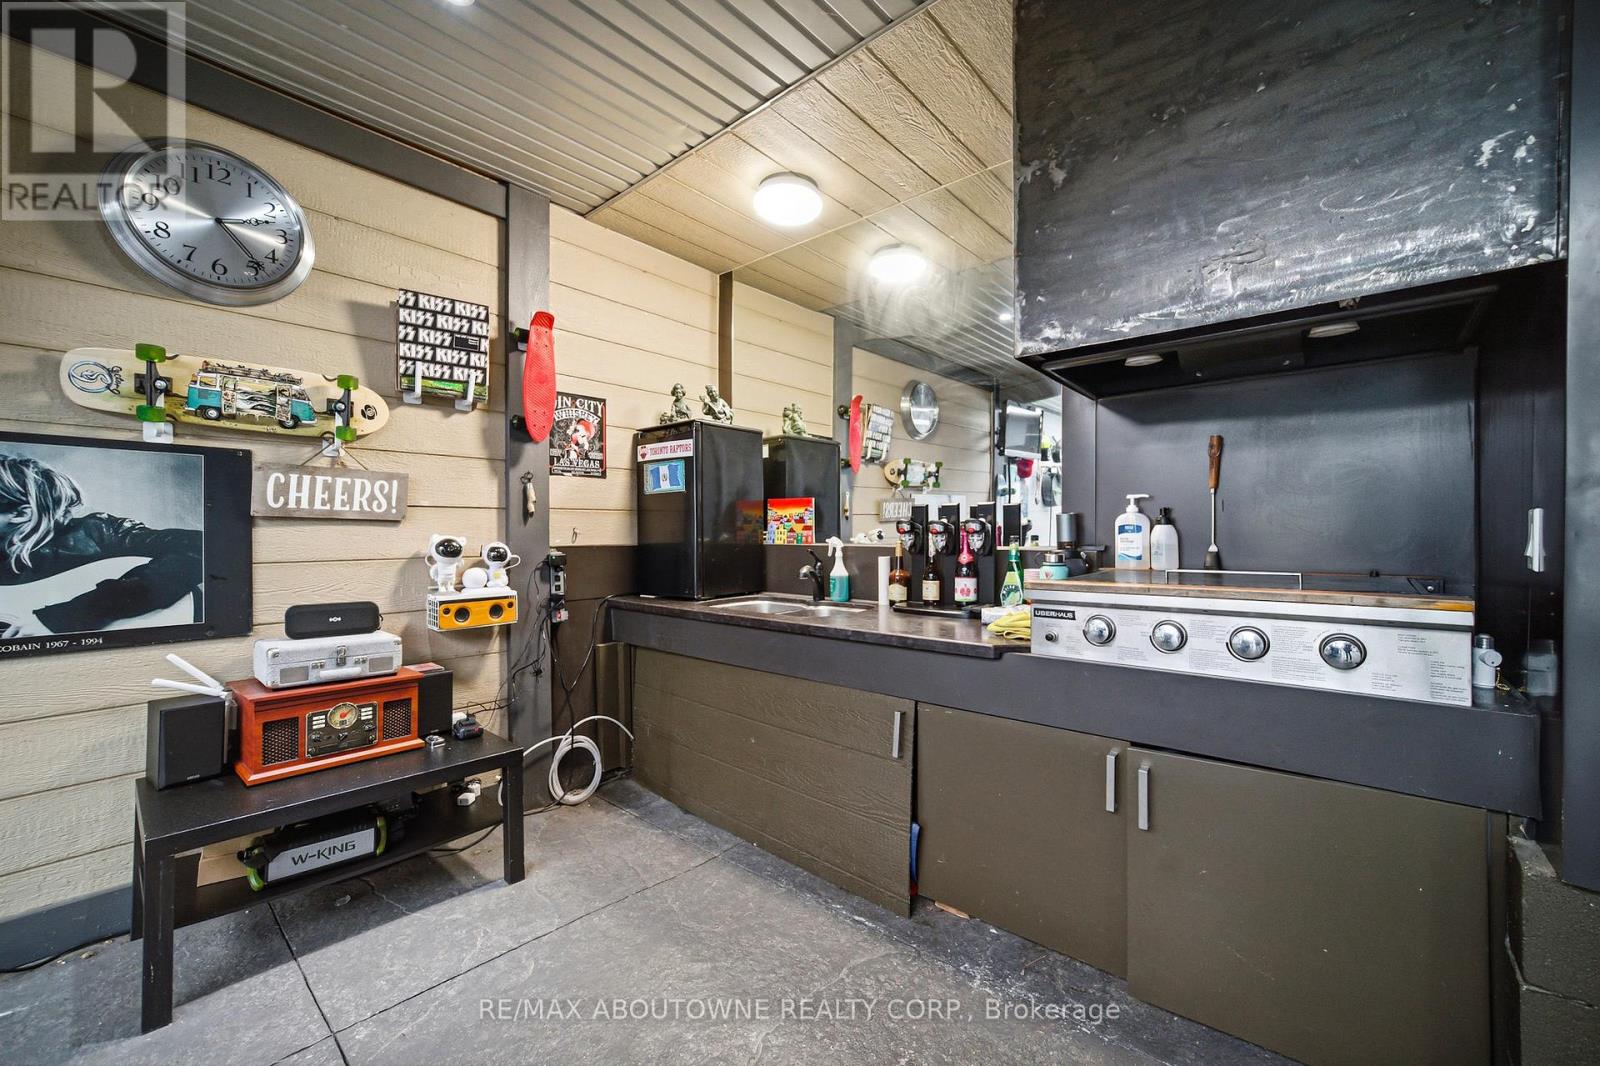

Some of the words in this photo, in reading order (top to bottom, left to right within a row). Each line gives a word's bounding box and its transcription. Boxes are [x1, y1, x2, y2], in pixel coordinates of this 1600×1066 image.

[180, 162, 200, 184] 11
[206, 163, 231, 186] 12
[154, 174, 181, 195] 10
[246, 182, 252, 198] 1
[141, 192, 160, 211] 9
[264, 202, 277, 219] 2
[153, 221, 171, 239] 8
[276, 229, 288, 245] 3
[183, 244, 198, 262] 7
[265, 248, 279, 264] 4
[211, 259, 228, 276] 6
[399, 290, 416, 307] SS
[418, 294, 453, 314] KISS
[454, 301, 487, 320] KISS
[399, 308, 435, 327] KISS
[436, 314, 471, 333] KISS
[471, 320, 488, 336] KI
[399, 326, 416, 341] SS
[418, 328, 453, 347] KISS
[399, 342, 435, 361] KISS
[436, 347, 469, 366] KISS
[470, 352, 487, 367] KI
[399, 359, 415, 375] SS
[421, 361, 452, 380] KISS
[557, 395, 572, 409] IN
[576, 398, 605, 418] CITY
[554, 457, 571, 467] LAS
[572, 459, 600, 469] VEGAS
[266, 472, 399, 514] CHEERS!
[45, 640, 70, 649] 1967
[81, 637, 103, 646] 1994
[291, 840, 356, 866] W-KING
